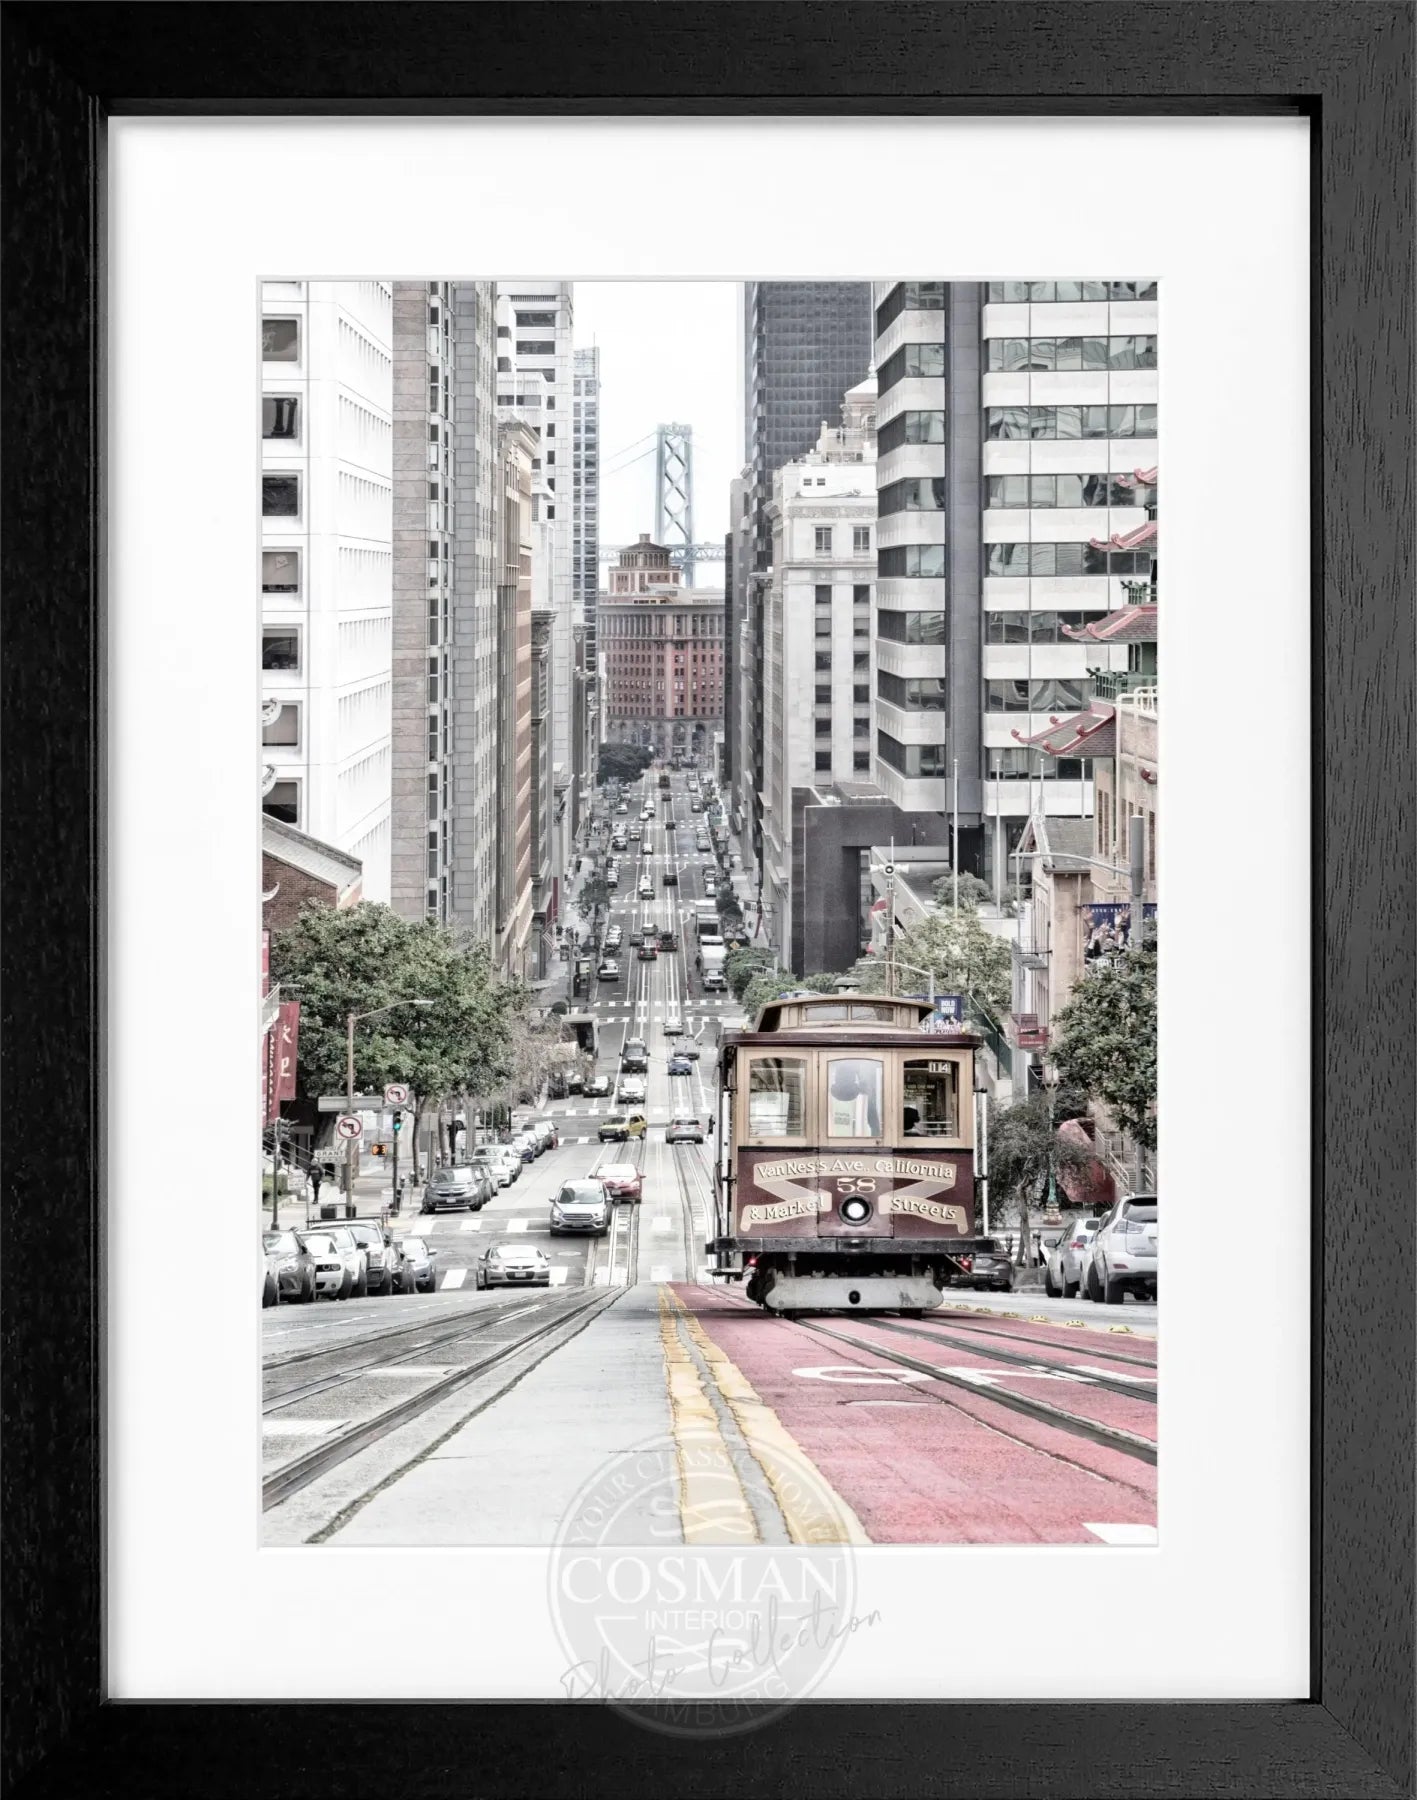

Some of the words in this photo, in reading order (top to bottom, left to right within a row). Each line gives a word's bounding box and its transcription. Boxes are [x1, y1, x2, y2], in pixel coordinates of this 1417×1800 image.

[757, 1165, 785, 1178] Van
[786, 1160, 827, 1175] Ness
[875, 1159, 953, 1179] California
[837, 1177, 876, 1193] 58
[750, 1207, 760, 1220] &
[765, 1196, 825, 1220] Market
[891, 1198, 957, 1220] Streets
